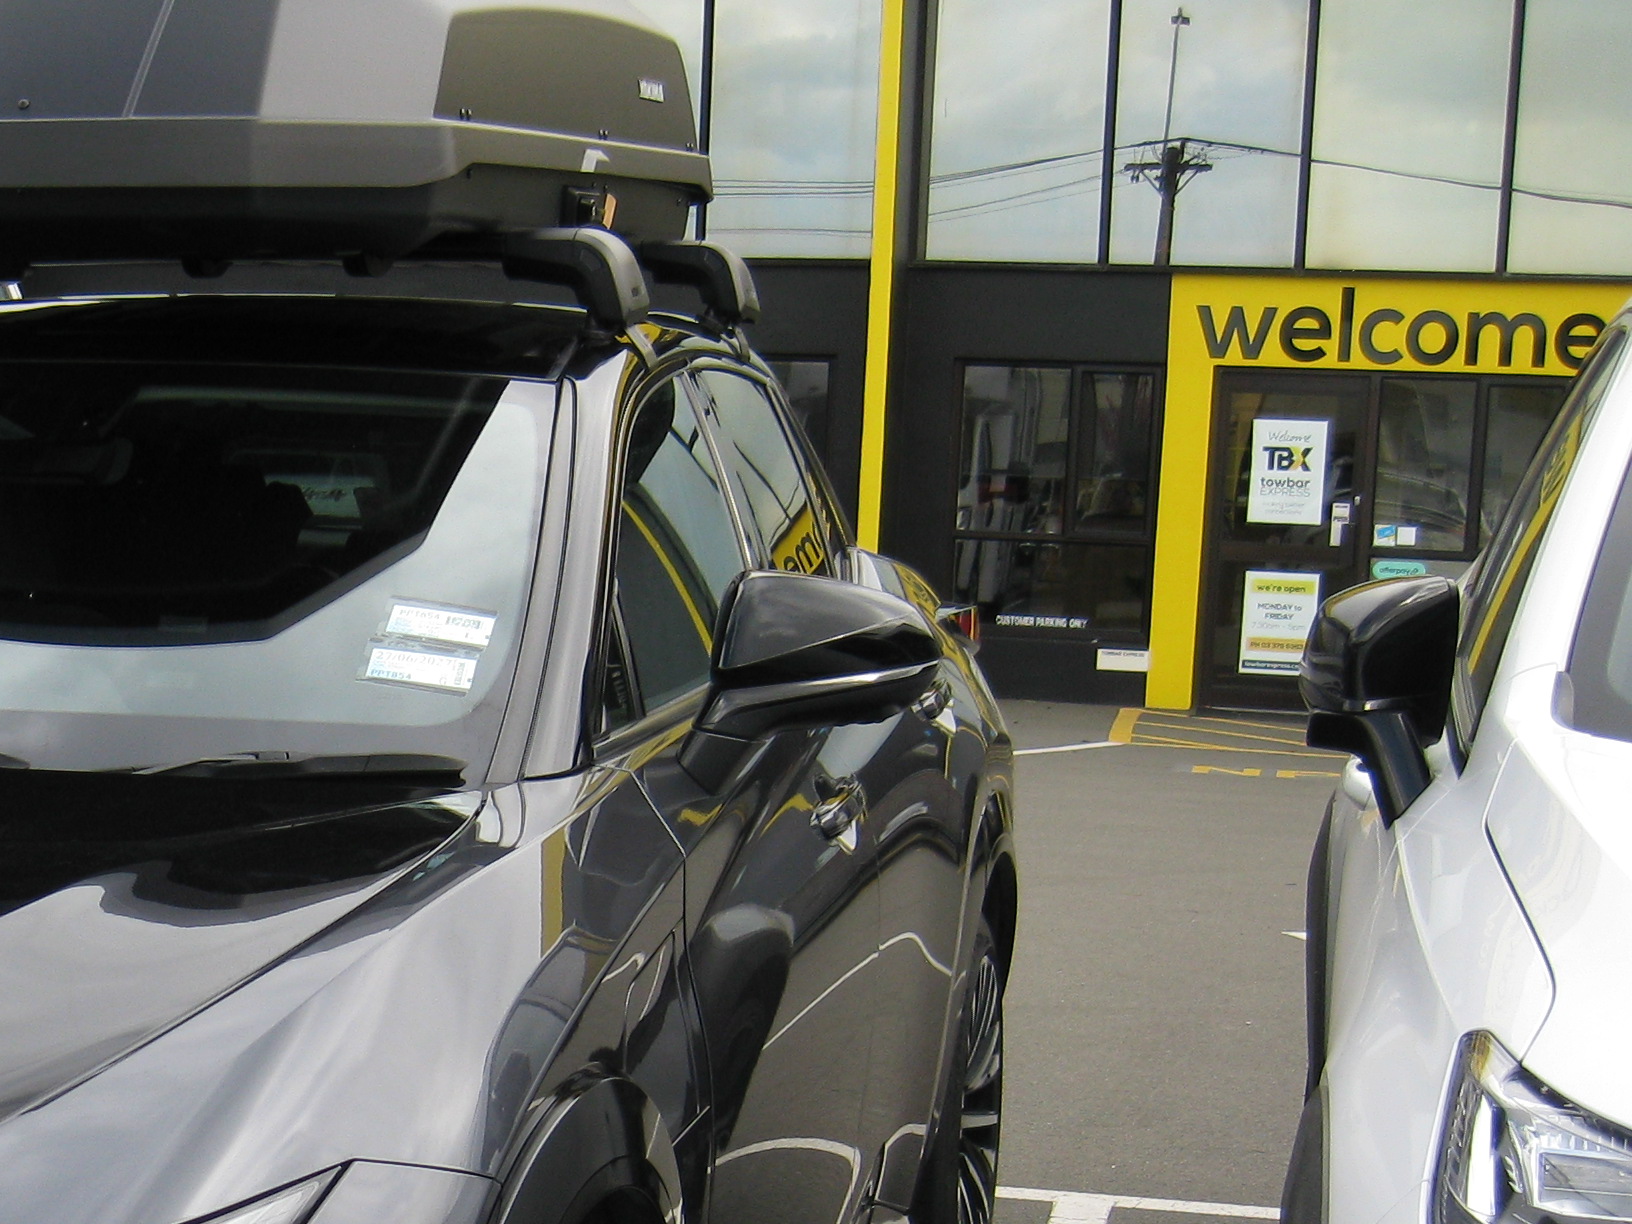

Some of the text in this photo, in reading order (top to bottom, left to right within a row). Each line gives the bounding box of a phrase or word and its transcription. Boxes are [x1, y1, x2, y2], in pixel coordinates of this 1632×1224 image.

[1196, 286, 1607, 370] welcome
[1262, 446, 1314, 472] TBX
[1260, 476, 1311, 489] towbar
[1259, 487, 1311, 498] EXPRESS
[1284, 586, 1306, 594] open
[1257, 602, 1293, 612] MONDAY
[995, 614, 1089, 629] CUSTOMER PARKING ONLY
[1264, 612, 1295, 621] FRIDAY
